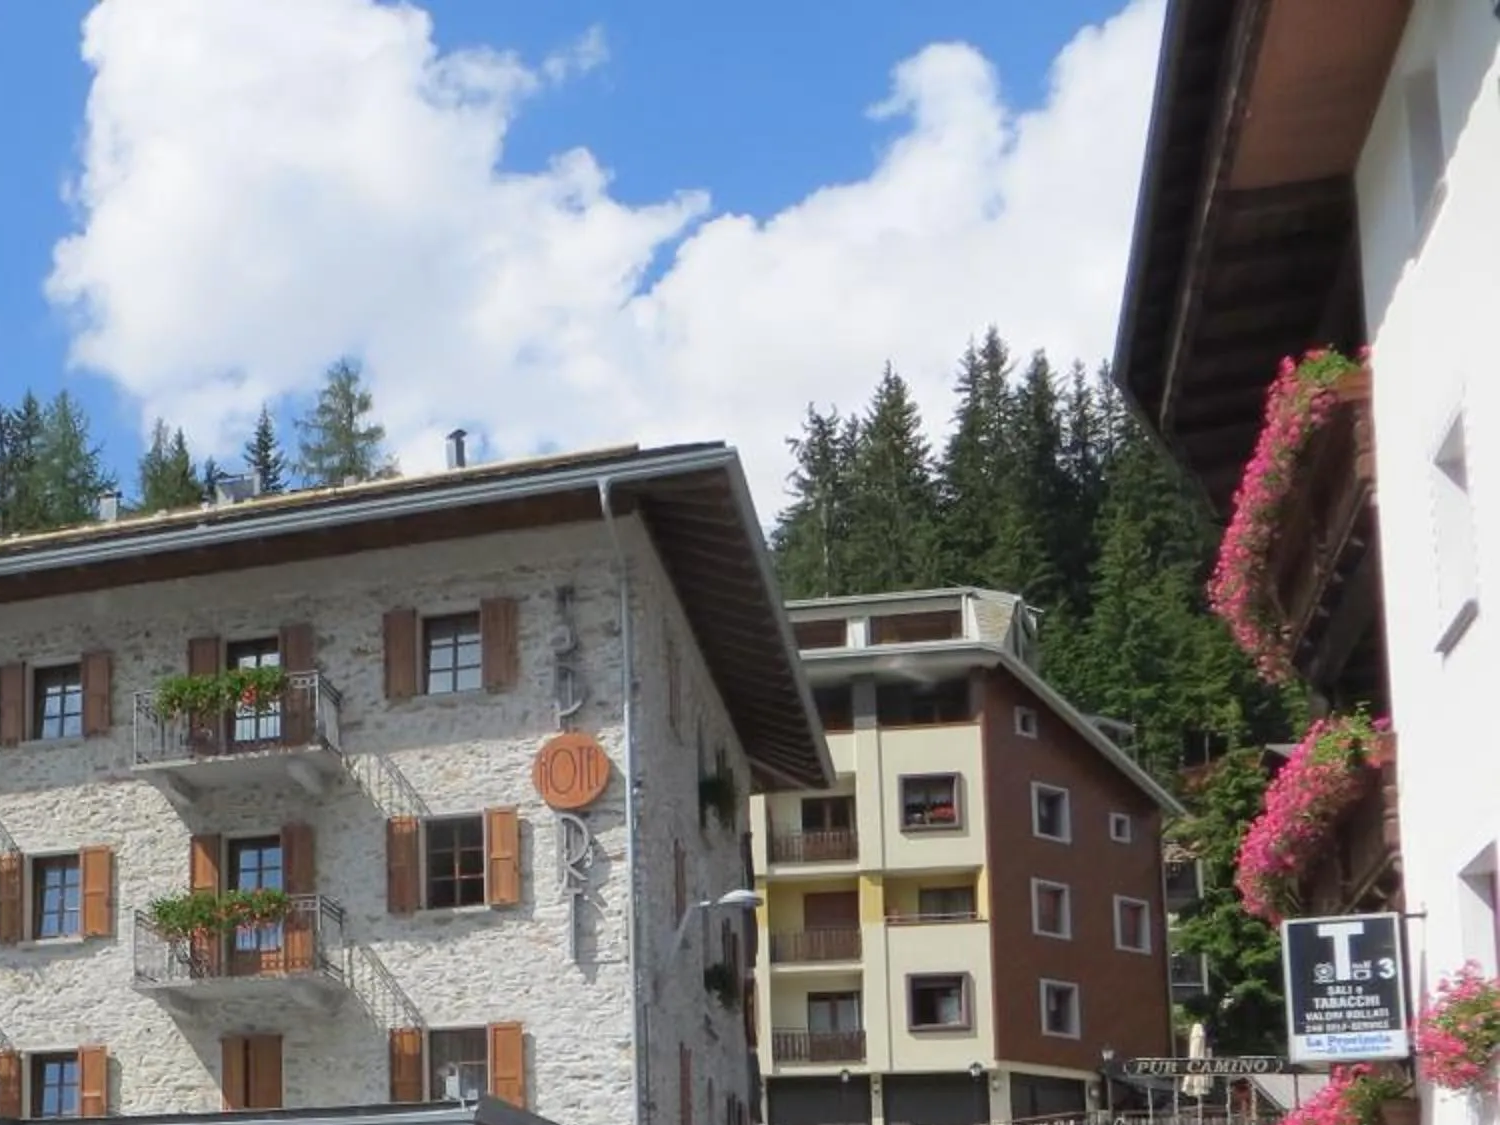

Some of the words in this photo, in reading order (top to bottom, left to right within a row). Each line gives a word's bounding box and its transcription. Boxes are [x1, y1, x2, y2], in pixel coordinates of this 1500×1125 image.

[1317, 922, 1364, 980] T
[1378, 958, 1396, 979] 3
[1313, 995, 1381, 1009] TABACCHI
